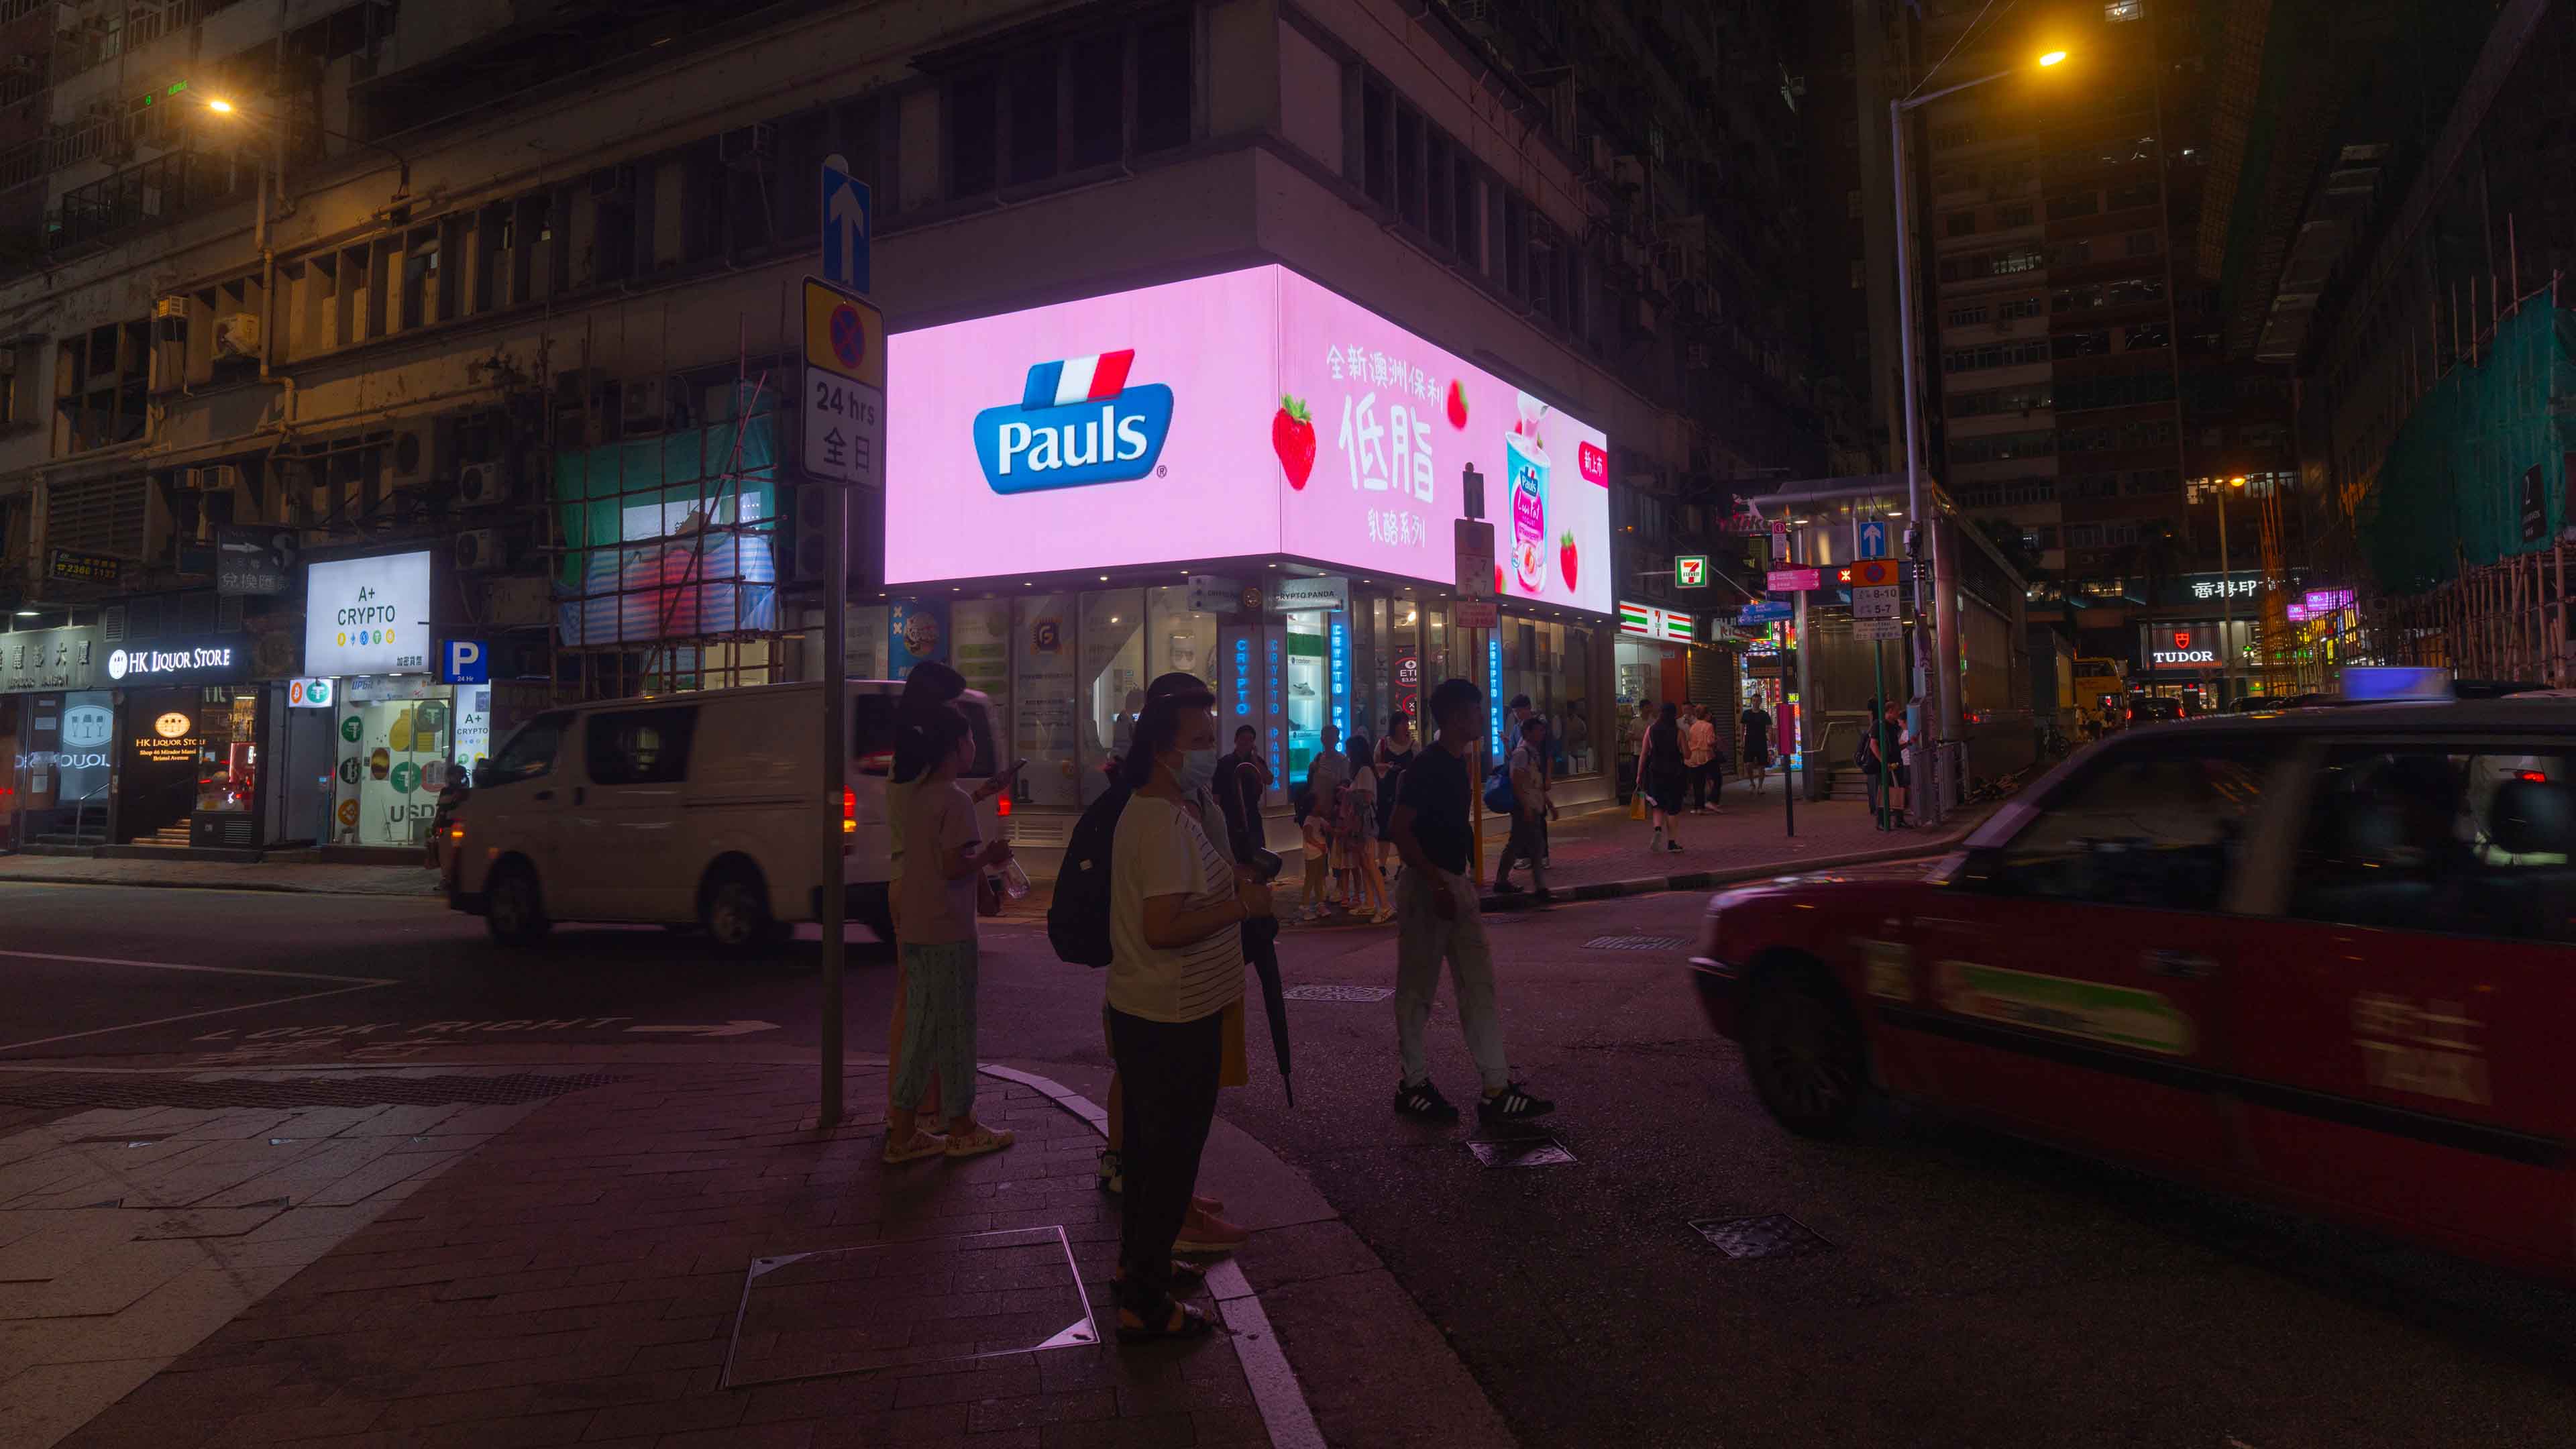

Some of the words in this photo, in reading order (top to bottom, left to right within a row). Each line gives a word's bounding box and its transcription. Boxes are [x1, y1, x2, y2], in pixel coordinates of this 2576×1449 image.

[1326, 344, 1444, 413] 全新澳洲保利
[816, 381, 844, 415] 24
[849, 391, 875, 426] hrs
[823, 427, 871, 472] 全日
[998, 405, 1148, 475] Pauls
[1338, 392, 1434, 504] 低脂
[1584, 450, 1603, 477] 新上市
[1521, 477, 1537, 493] Pauls
[1517, 491, 1529, 513] Low
[1529, 498, 1540, 521] Fat
[1368, 507, 1426, 548] 乳酪系列
[358, 586, 376, 602] A+
[1307, 590, 1335, 599] PANDA
[1874, 589, 1896, 598] 8-10
[337, 605, 396, 626] CRYPTO
[1874, 604, 1891, 614] 5-7
[128, 651, 149, 674] HK
[152, 649, 192, 672] LIQUOR
[193, 647, 231, 669] STORE
[452, 641, 479, 676] P
[1332, 625, 1342, 694] CRYPTO
[1489, 641, 1497, 698] CRYPTO
[2153, 651, 2214, 663] TUDOR
[1236, 639, 1248, 715] CRYPTO
[1271, 640, 1279, 714] CRYPTO
[456, 727, 489, 735] CRYPTO
[464, 713, 482, 724] A+
[1491, 708, 1499, 755] PANDA
[136, 739, 151, 747] HK
[153, 739, 182, 747] LIQUOR
[1271, 727, 1280, 790] PANDA
[390, 804, 441, 823] USD
[193, 1021, 400, 1042] LOOK
[407, 1016, 634, 1036] RIGHT
